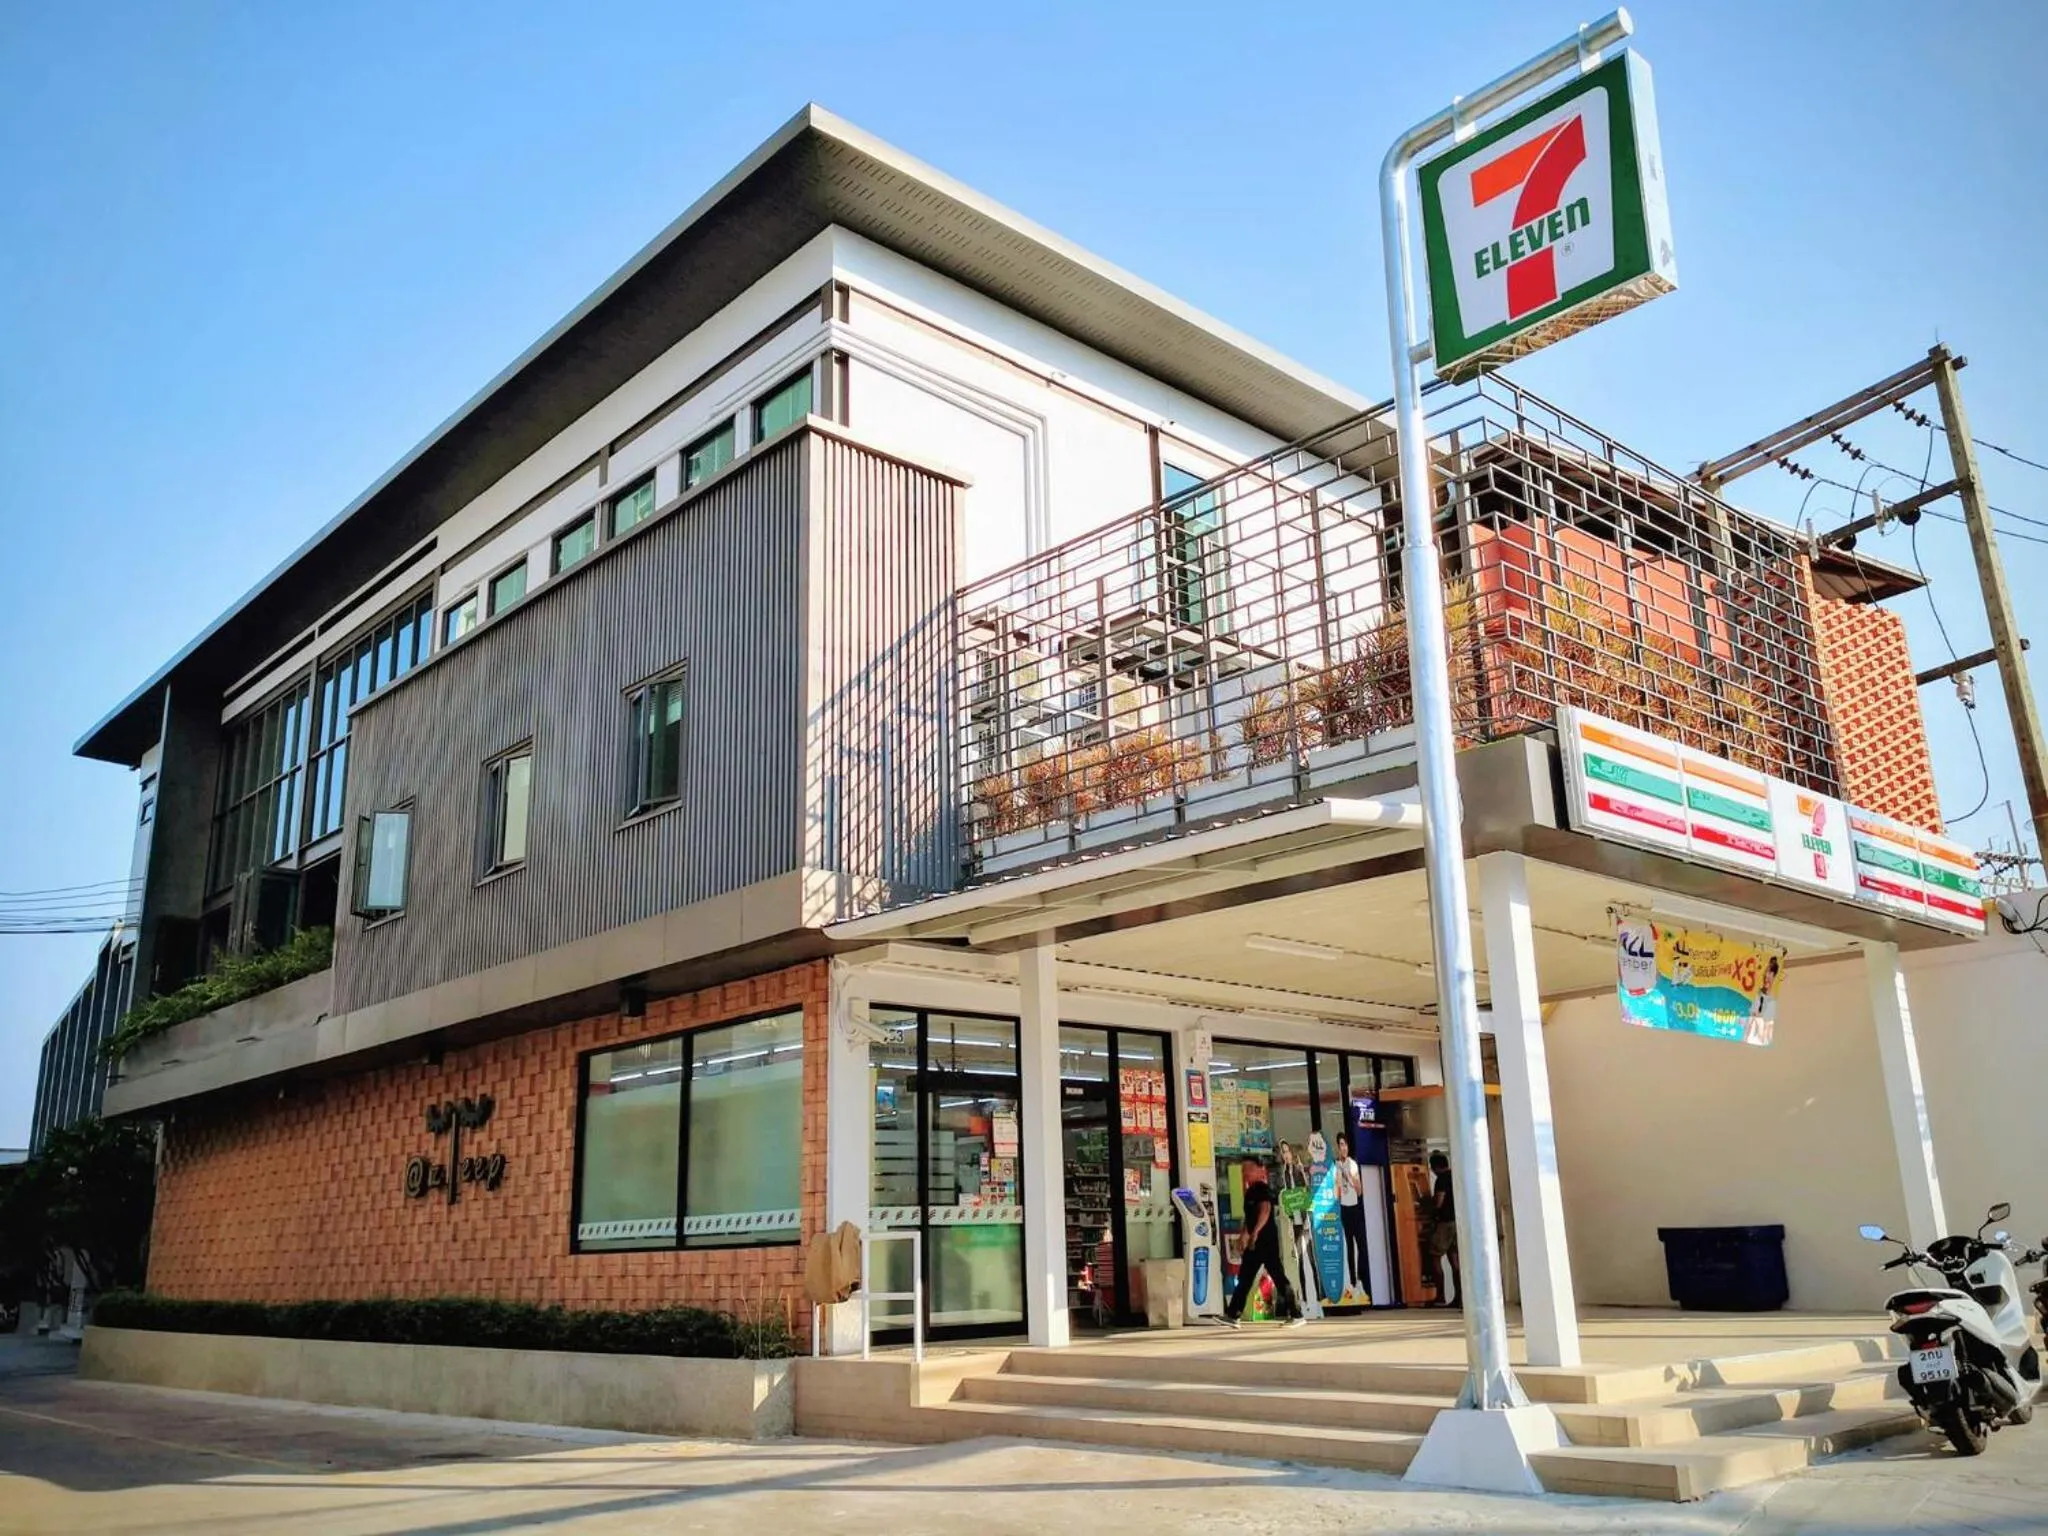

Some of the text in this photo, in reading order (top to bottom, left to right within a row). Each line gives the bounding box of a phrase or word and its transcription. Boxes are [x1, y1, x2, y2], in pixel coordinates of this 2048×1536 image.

[1469, 113, 1587, 322] 7
[1796, 793, 1827, 879] 7
[1920, 1368, 1950, 1380] 9519
